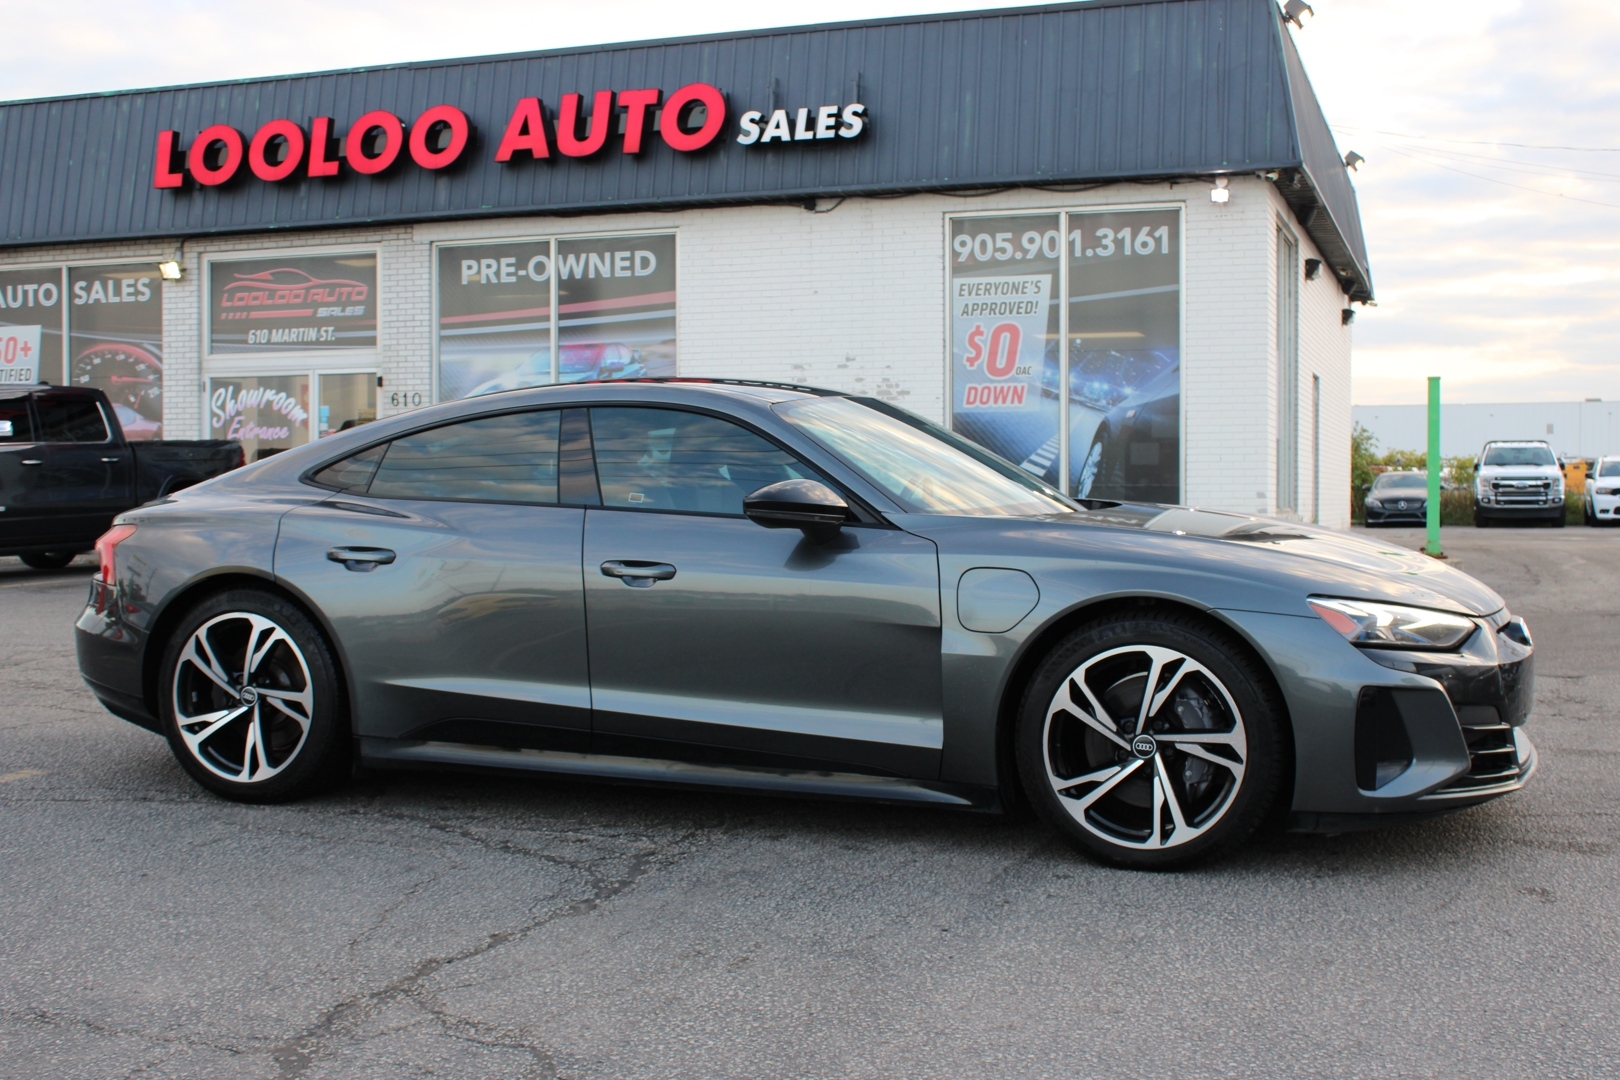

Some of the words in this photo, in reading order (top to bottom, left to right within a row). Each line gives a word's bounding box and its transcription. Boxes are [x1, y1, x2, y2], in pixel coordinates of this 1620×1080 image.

[154, 104, 470, 189] LOOLOO
[494, 82, 726, 163] AUTO
[736, 103, 866, 146] SALES
[953, 225, 1169, 262] 905.901.3161
[461, 250, 657, 285] PRE-OWNED
[73, 277, 151, 305] SALES
[221, 289, 305, 307] LOOLOO
[307, 286, 368, 303] AUTO
[958, 280, 1041, 298] EVERYONE'S
[316, 305, 366, 317] SALES
[961, 300, 1038, 318] APPROVED!
[248, 329, 269, 344] 610
[270, 327, 318, 343] MARTIN
[319, 326, 336, 341] ST.
[965, 322, 1021, 378] $0
[212, 385, 308, 428] Showroom
[391, 392, 422, 407] 610
[964, 384, 1025, 406] DOWN
[227, 416, 290, 440] Entrance
